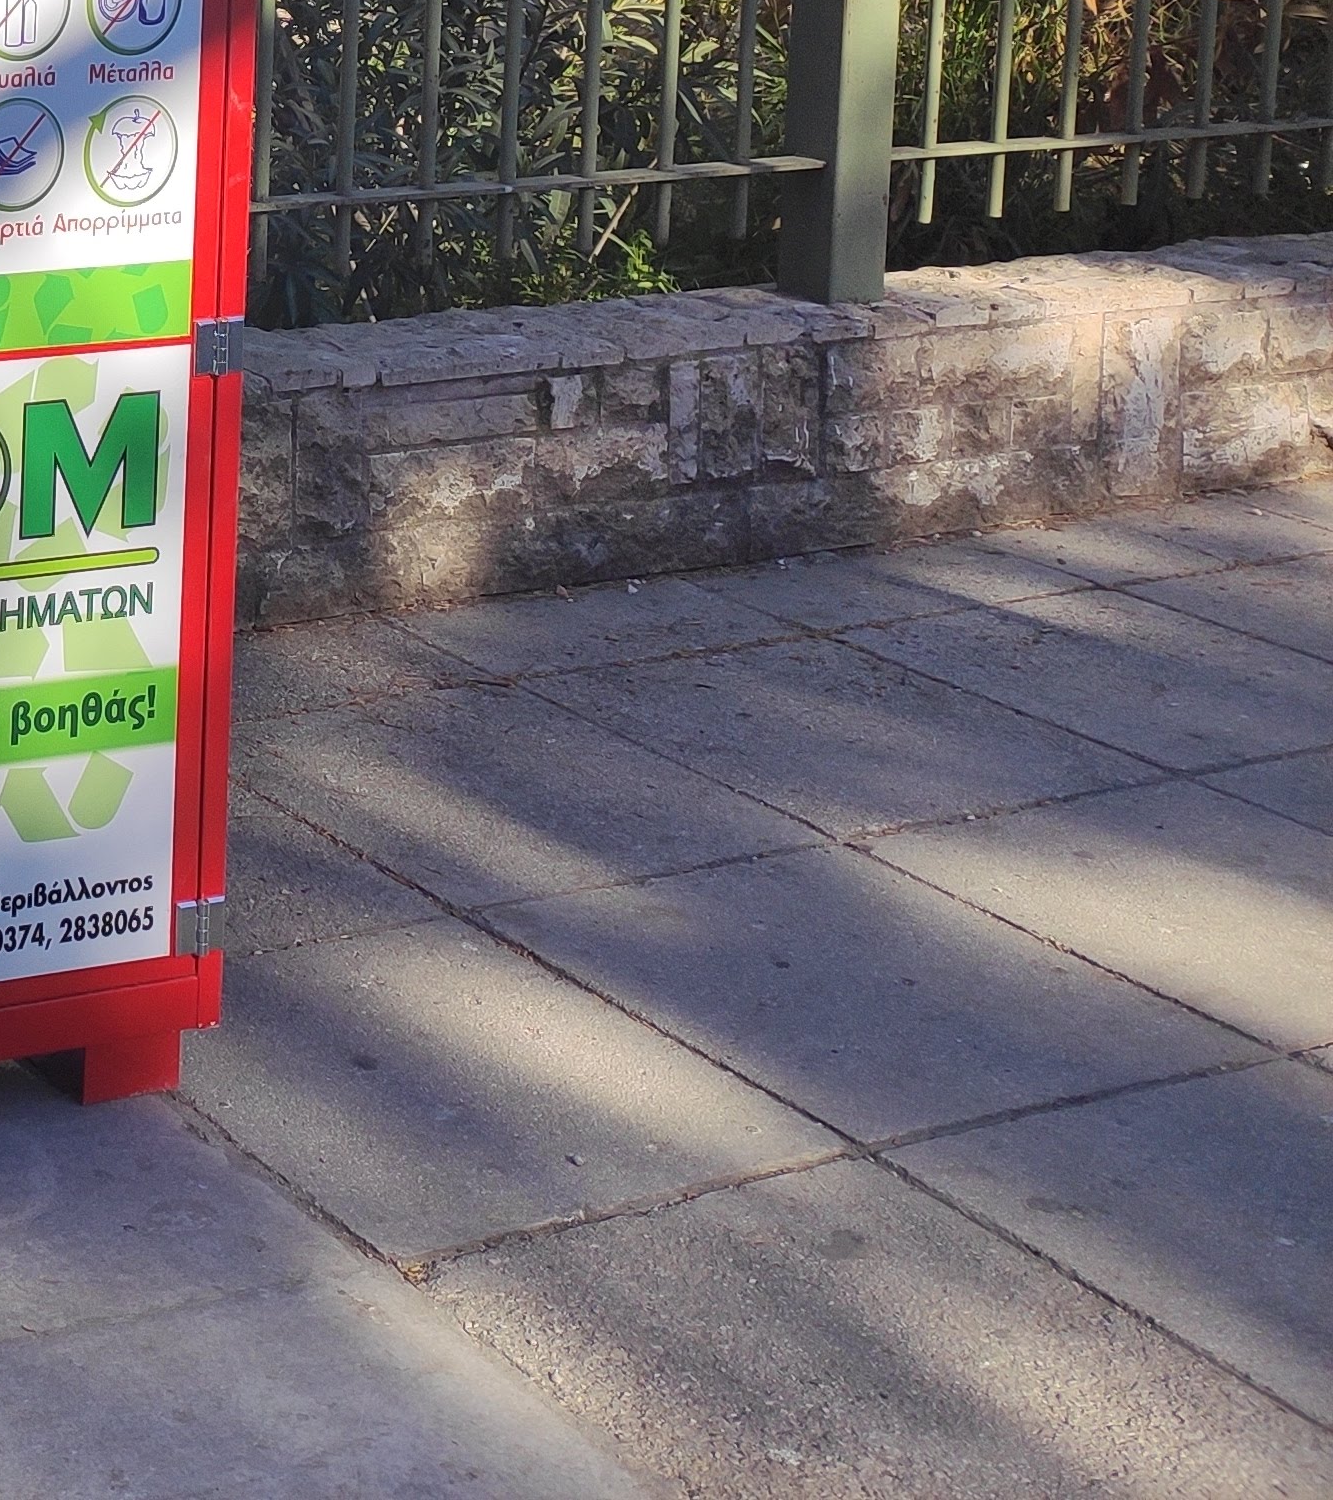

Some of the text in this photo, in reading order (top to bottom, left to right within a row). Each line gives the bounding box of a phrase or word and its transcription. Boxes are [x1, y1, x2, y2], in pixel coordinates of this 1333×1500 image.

[88, 60, 175, 85] Μέταλλα
[52, 209, 182, 236] Απορρίμματα
[10, 684, 157, 746] βοηθάς!
[59, 905, 155, 944] 2838065
